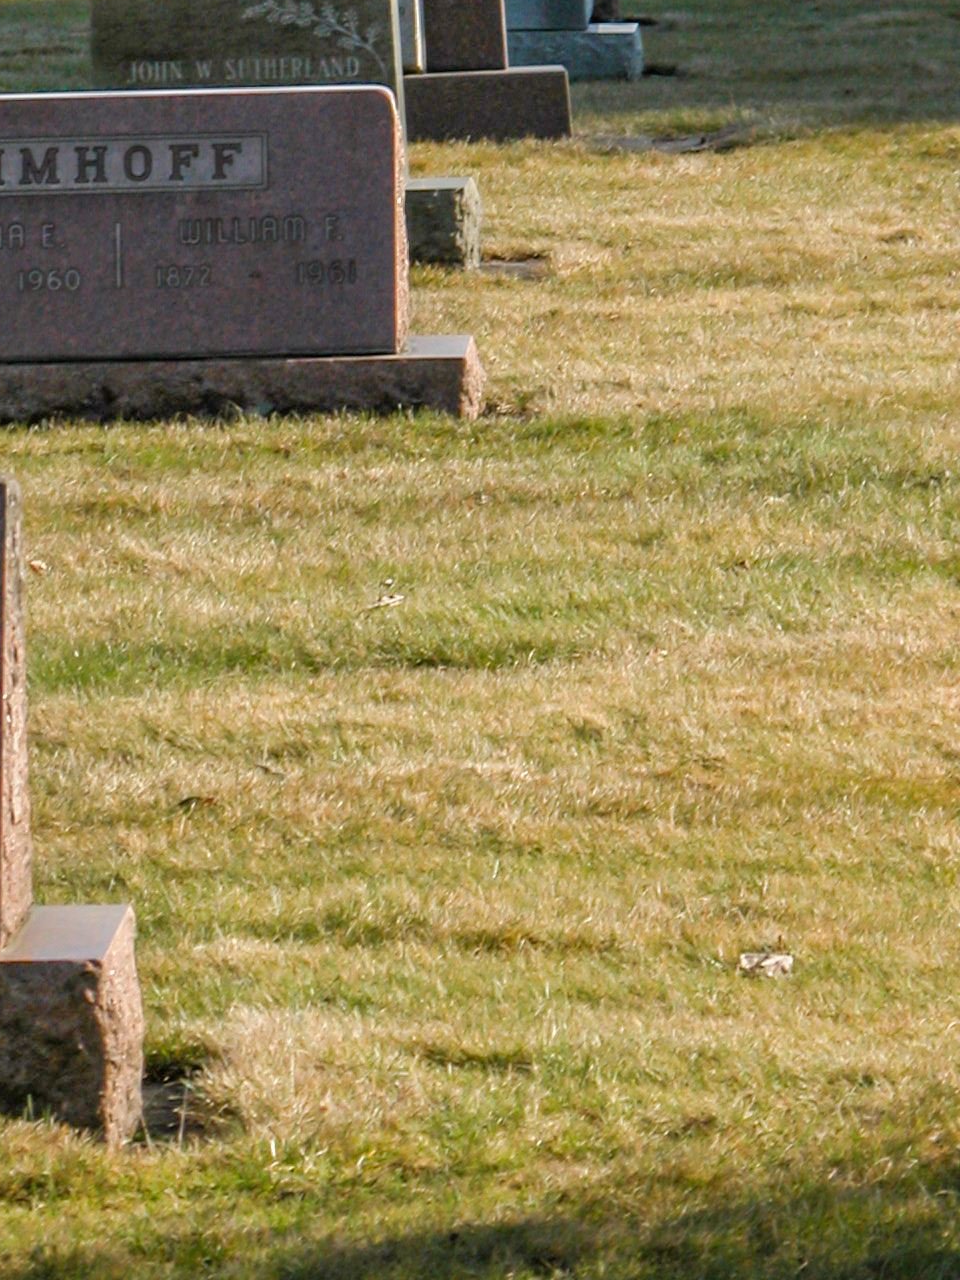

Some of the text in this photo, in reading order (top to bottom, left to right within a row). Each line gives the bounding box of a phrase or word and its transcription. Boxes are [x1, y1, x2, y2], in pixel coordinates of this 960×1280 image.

[127, 56, 361, 83] JOHN W SUTHERLAND
[179, 214, 307, 245] WILLIAM
[16, 267, 82, 292] 1960
[155, 264, 213, 288] 1872
